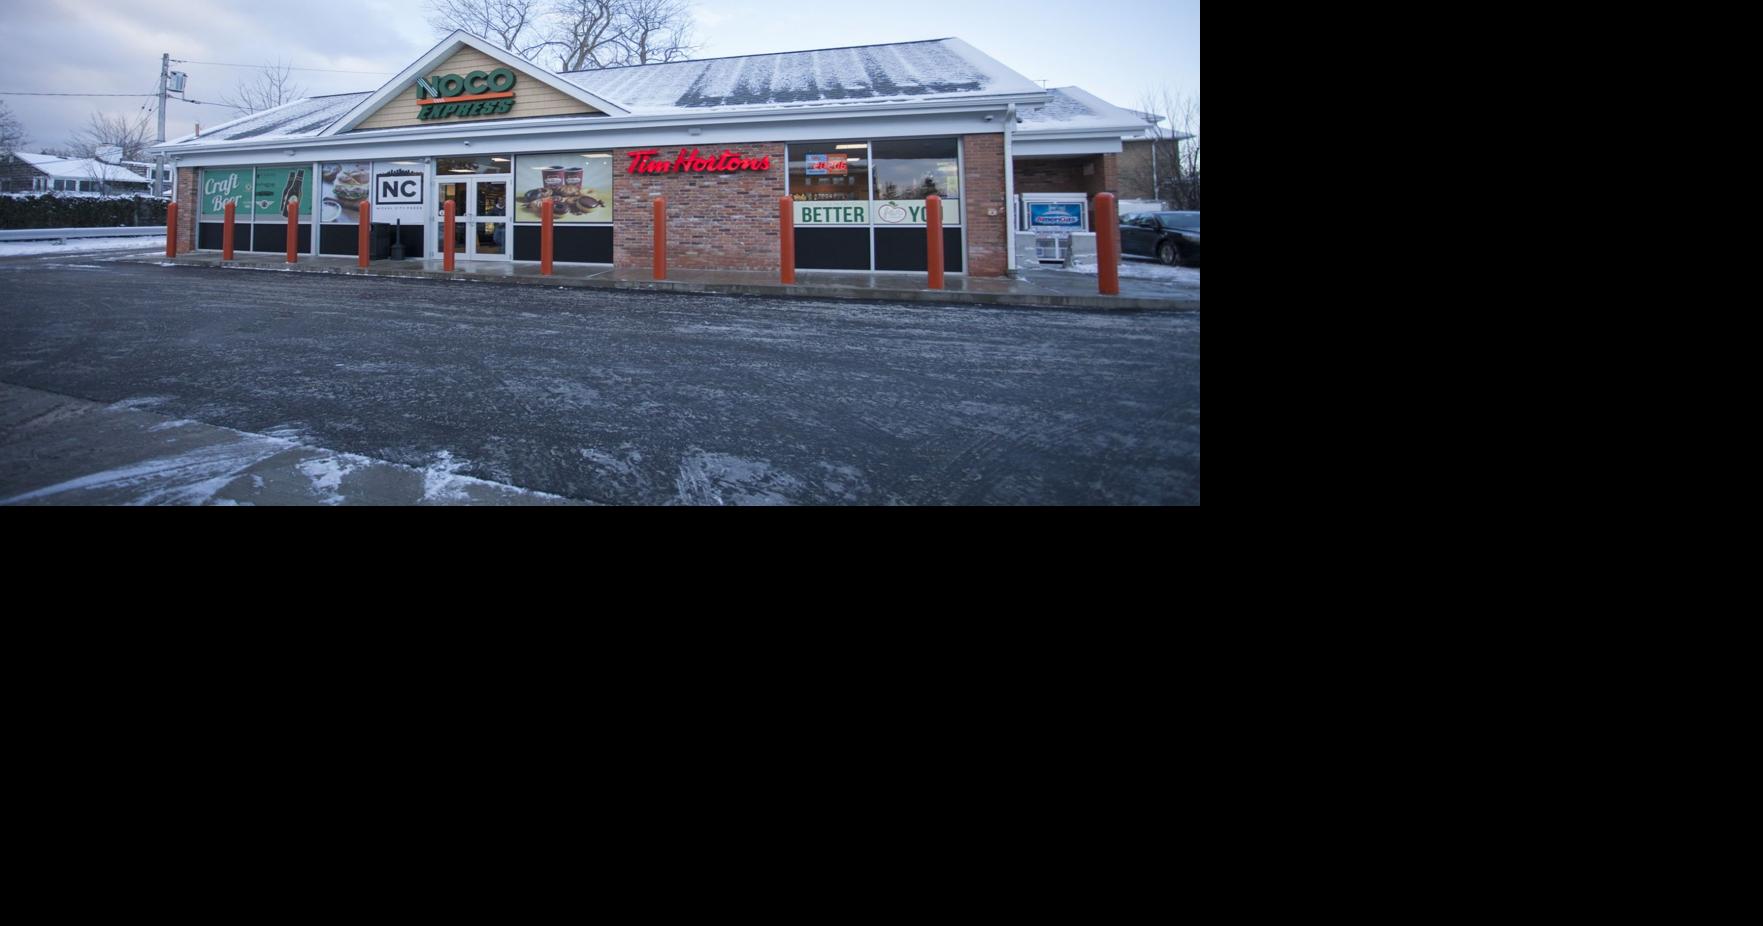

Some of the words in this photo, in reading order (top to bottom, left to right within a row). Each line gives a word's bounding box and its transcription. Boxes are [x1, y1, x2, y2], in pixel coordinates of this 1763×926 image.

[416, 68, 517, 102] NOCO
[417, 98, 516, 121] EXPRESS
[627, 149, 670, 174] Tim
[673, 147, 770, 173] Hortons
[205, 173, 239, 195] Craft
[383, 180, 416, 197] NC
[802, 206, 864, 222] BETTER
[909, 206, 943, 222] YO
